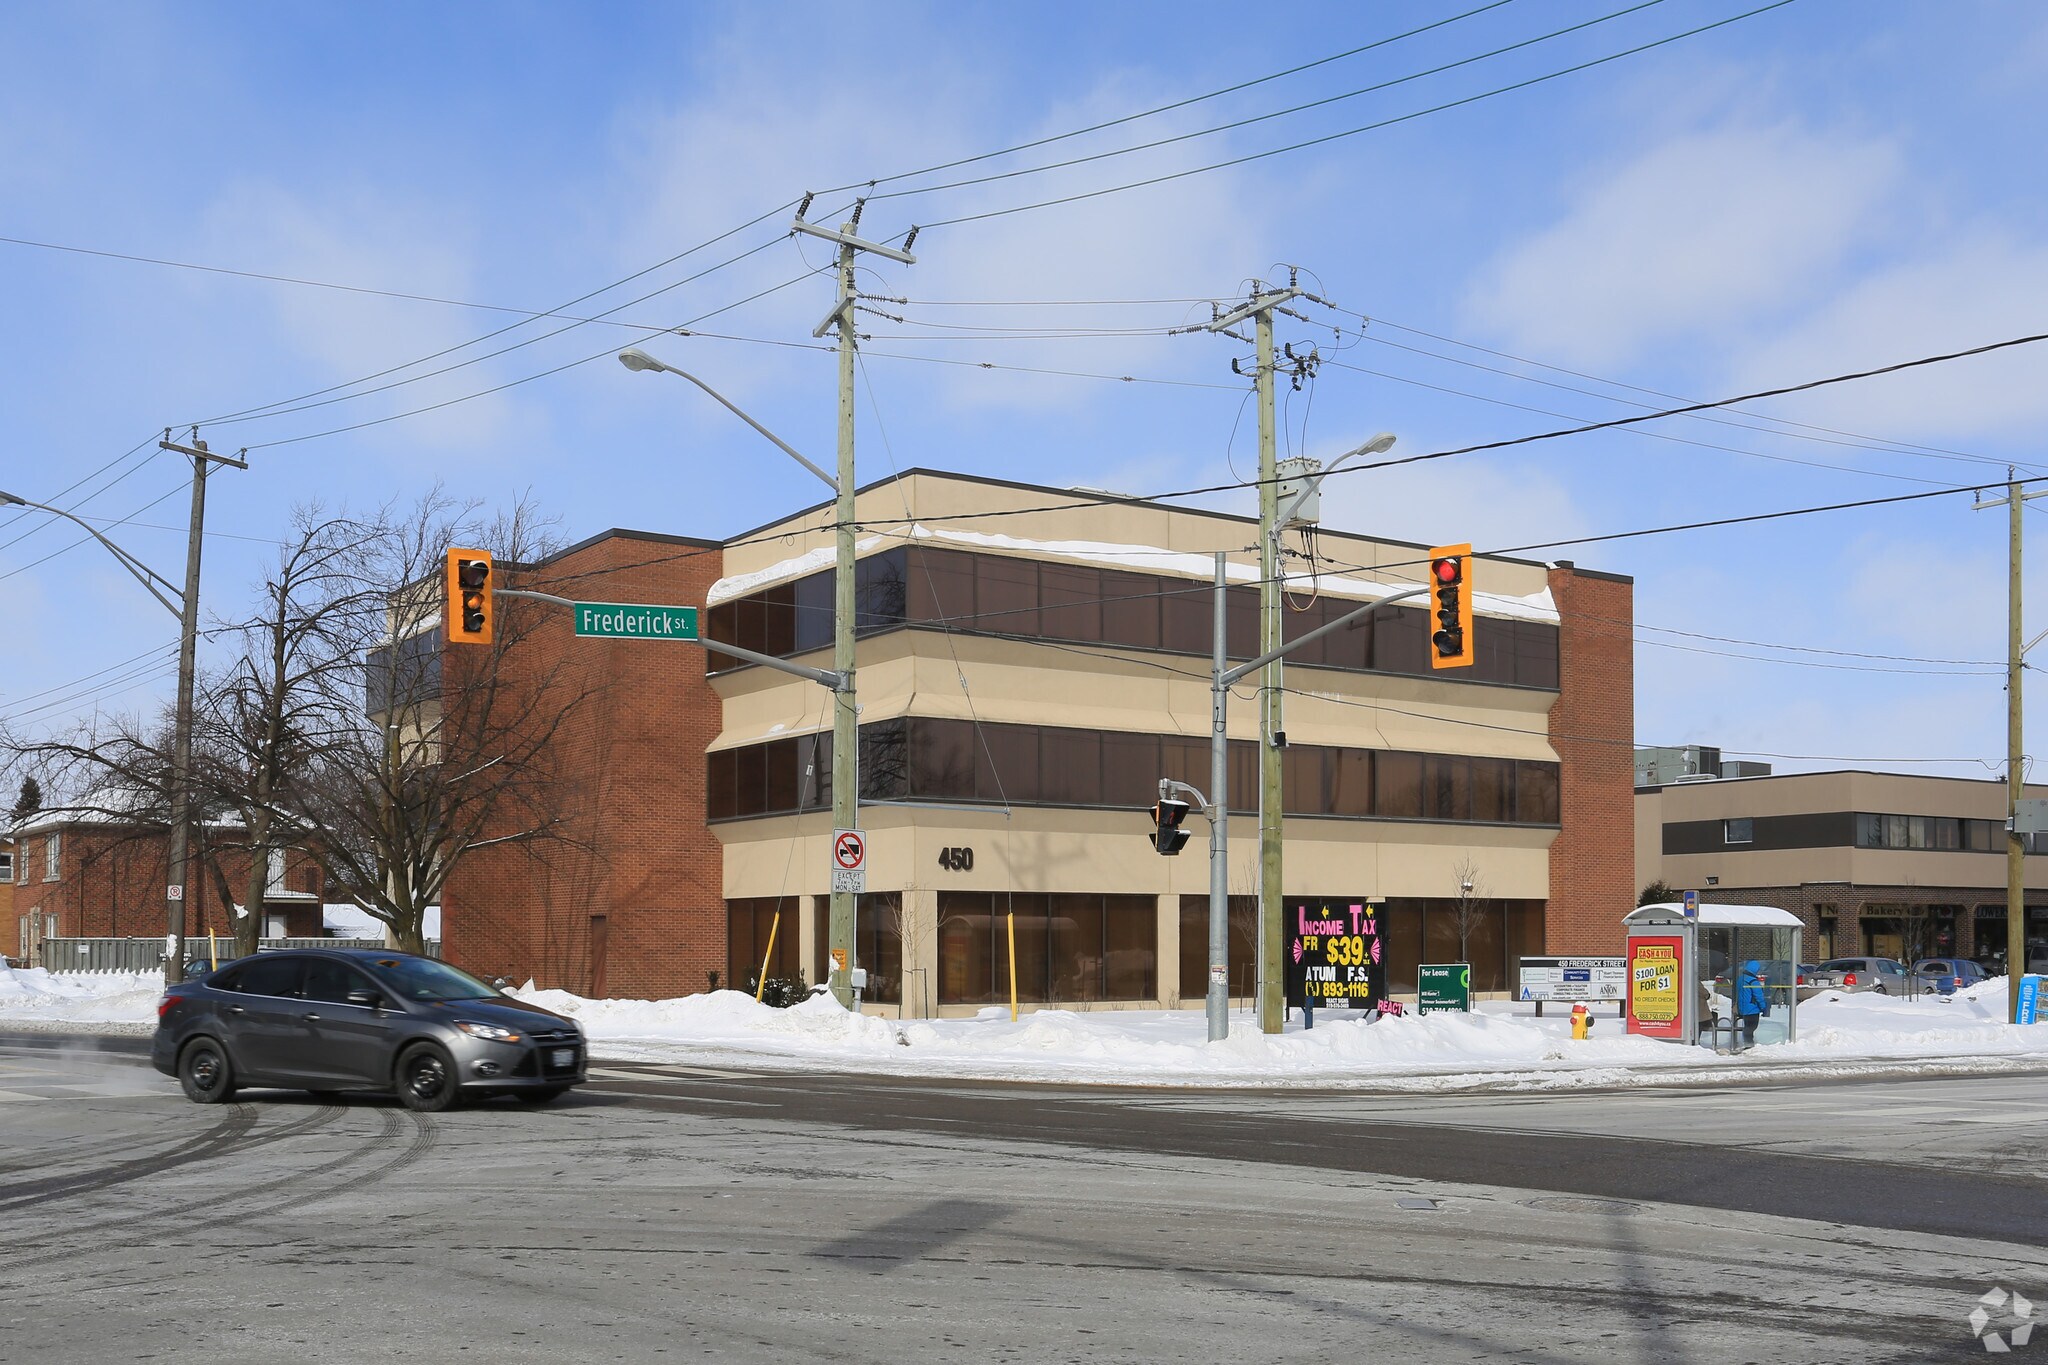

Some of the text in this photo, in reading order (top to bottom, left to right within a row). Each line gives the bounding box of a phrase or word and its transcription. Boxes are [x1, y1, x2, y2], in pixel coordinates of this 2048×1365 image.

[583, 610, 689, 634] Frederick St.
[938, 847, 974, 871] 450
[837, 872, 860, 880] EXCEPT
[1867, 905, 1903, 917] Bakery
[1298, 905, 1376, 935] INCOME TAX
[1303, 936, 1318, 951] FR
[1326, 936, 1363, 966] $39
[1660, 950, 1672, 958] YOU
[1305, 966, 1369, 982] ATUM F.S.
[1421, 968, 1449, 977] For Lease
[1635, 964, 1675, 980] $100 LOAN
[1322, 982, 1369, 998] 893-1116
[1640, 977, 1669, 992] FOR $1
[1377, 1000, 1403, 1015] REACT
